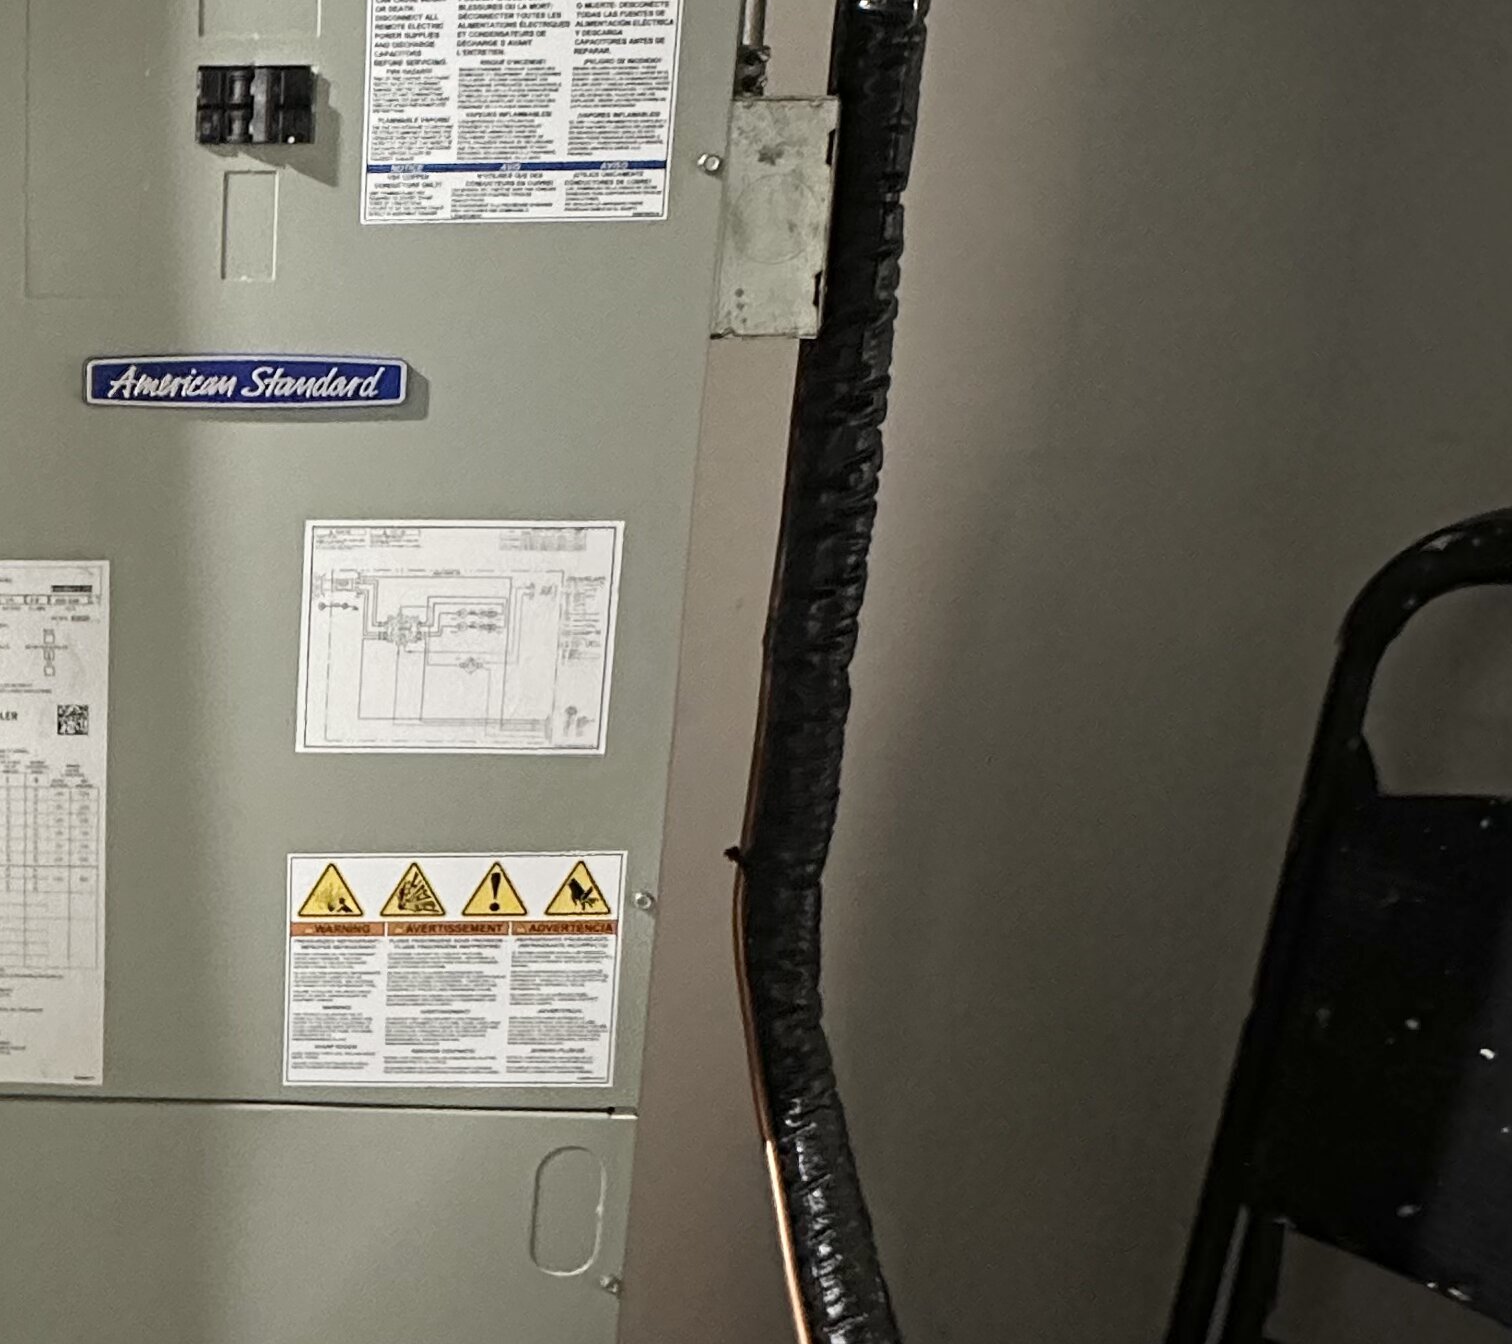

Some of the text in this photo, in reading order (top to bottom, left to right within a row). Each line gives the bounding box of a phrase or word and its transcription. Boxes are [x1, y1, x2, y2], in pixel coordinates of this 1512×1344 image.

[108, 364, 385, 399] American Standard
[315, 923, 371, 934] WARNING
[405, 922, 503, 934] AVERTISSEMENT
[529, 923, 613, 933] ADVERTENCIA
